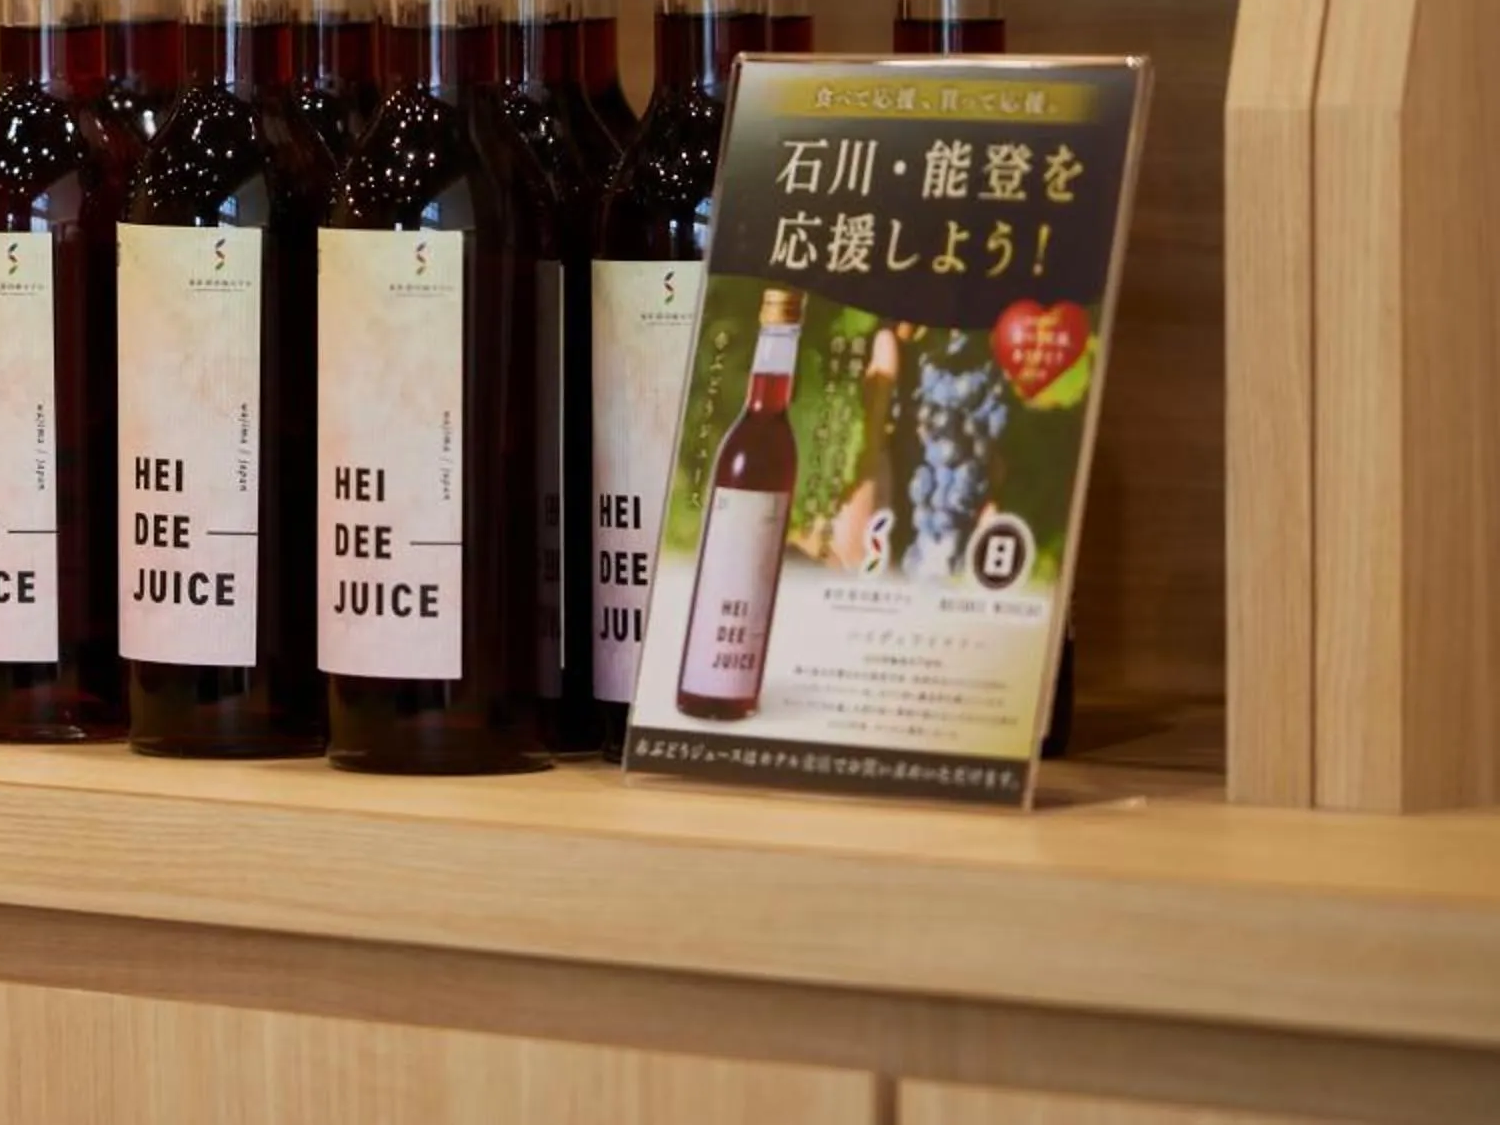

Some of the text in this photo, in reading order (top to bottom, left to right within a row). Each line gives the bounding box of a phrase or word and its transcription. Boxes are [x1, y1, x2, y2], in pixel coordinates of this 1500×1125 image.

[776, 138, 1084, 203] 石川・能登を
[135, 456, 183, 492] HEI
[335, 465, 385, 502] HEI
[599, 493, 641, 529] HEI
[135, 511, 191, 549] DEE
[335, 522, 392, 560] DEE
[599, 549, 649, 586] DEE
[133, 567, 236, 607] JUICE
[333, 579, 440, 618] JUICE
[599, 605, 642, 643] JUI
[721, 599, 750, 618] HEI
[716, 625, 746, 644] DEE
[711, 652, 756, 671] JUICE
